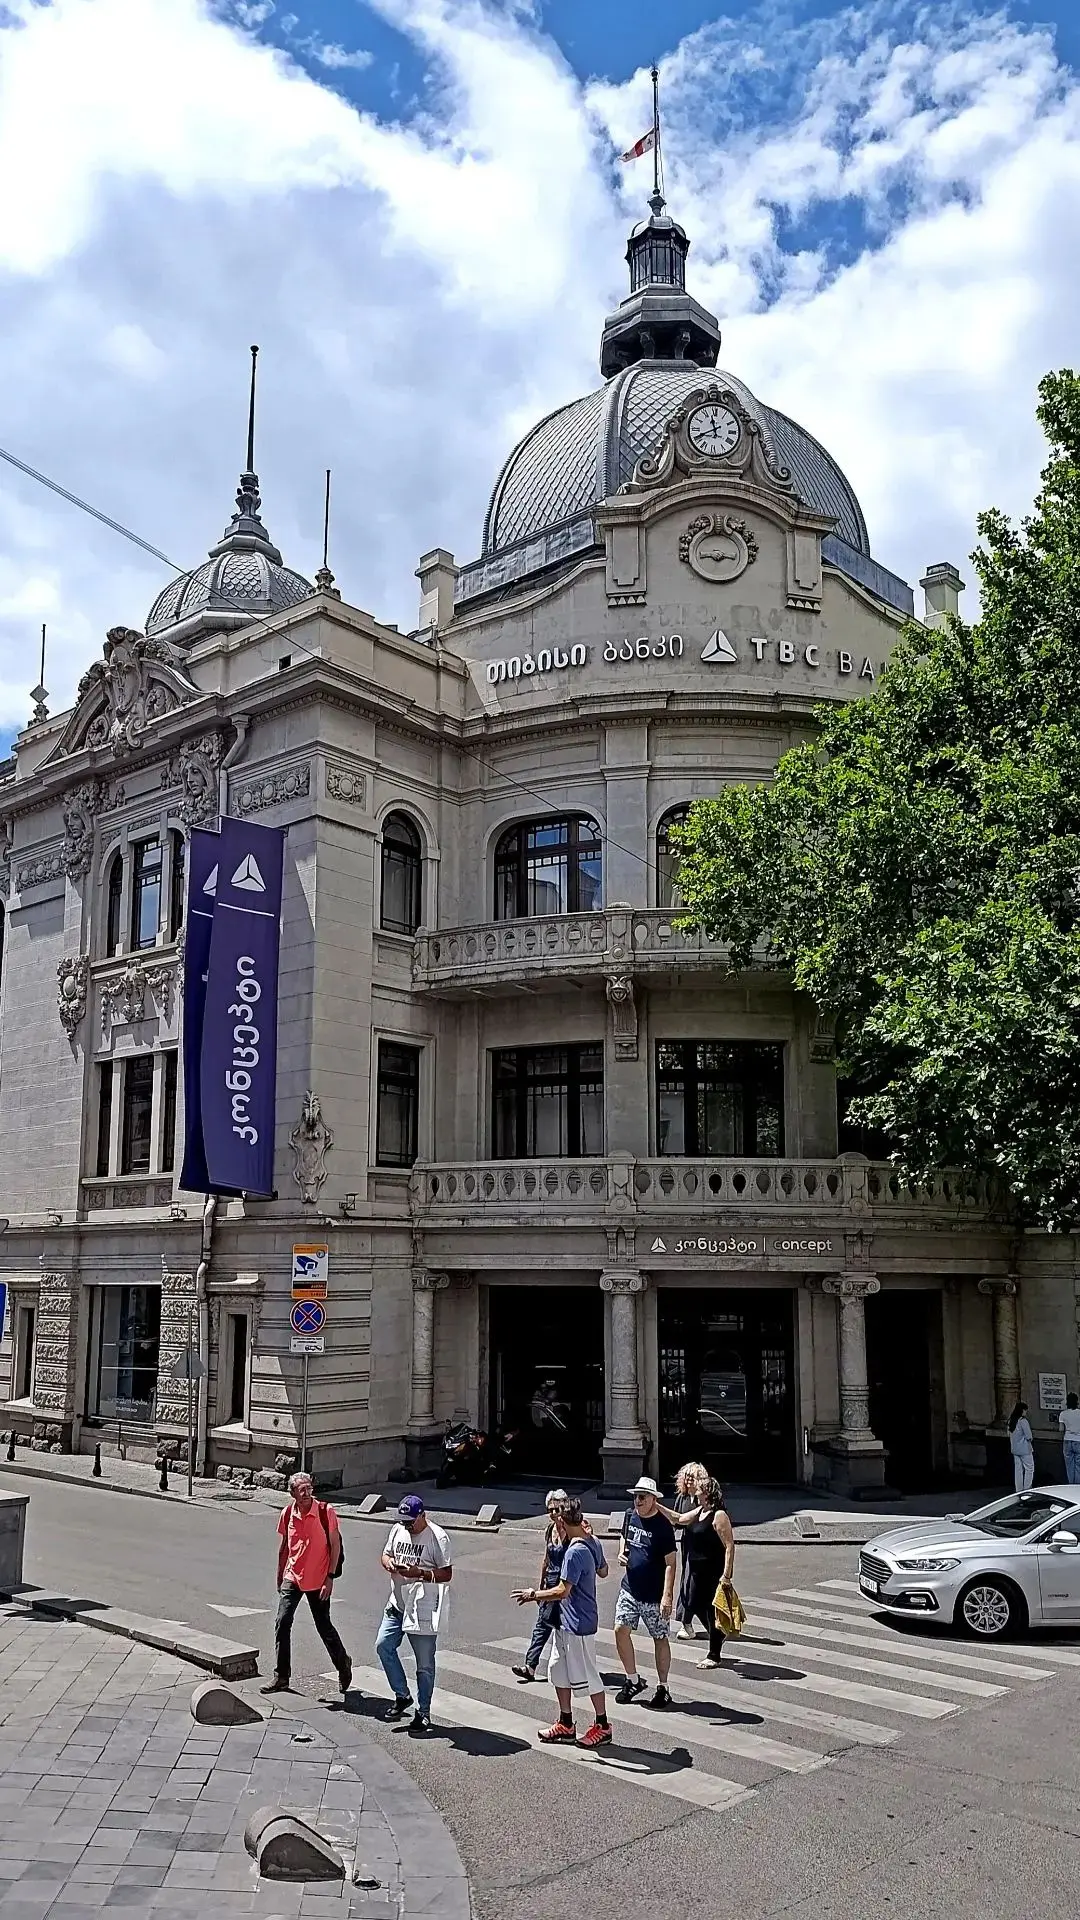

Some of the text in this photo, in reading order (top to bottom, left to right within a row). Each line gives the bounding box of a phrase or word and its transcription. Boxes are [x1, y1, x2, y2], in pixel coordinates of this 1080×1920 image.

[487, 634, 684, 685] თიბისი ბანკი
[750, 637, 820, 667] TBC
[225, 956, 262, 1146] კონცეპტი
[674, 1236, 832, 1254] კონცეპტი concept
